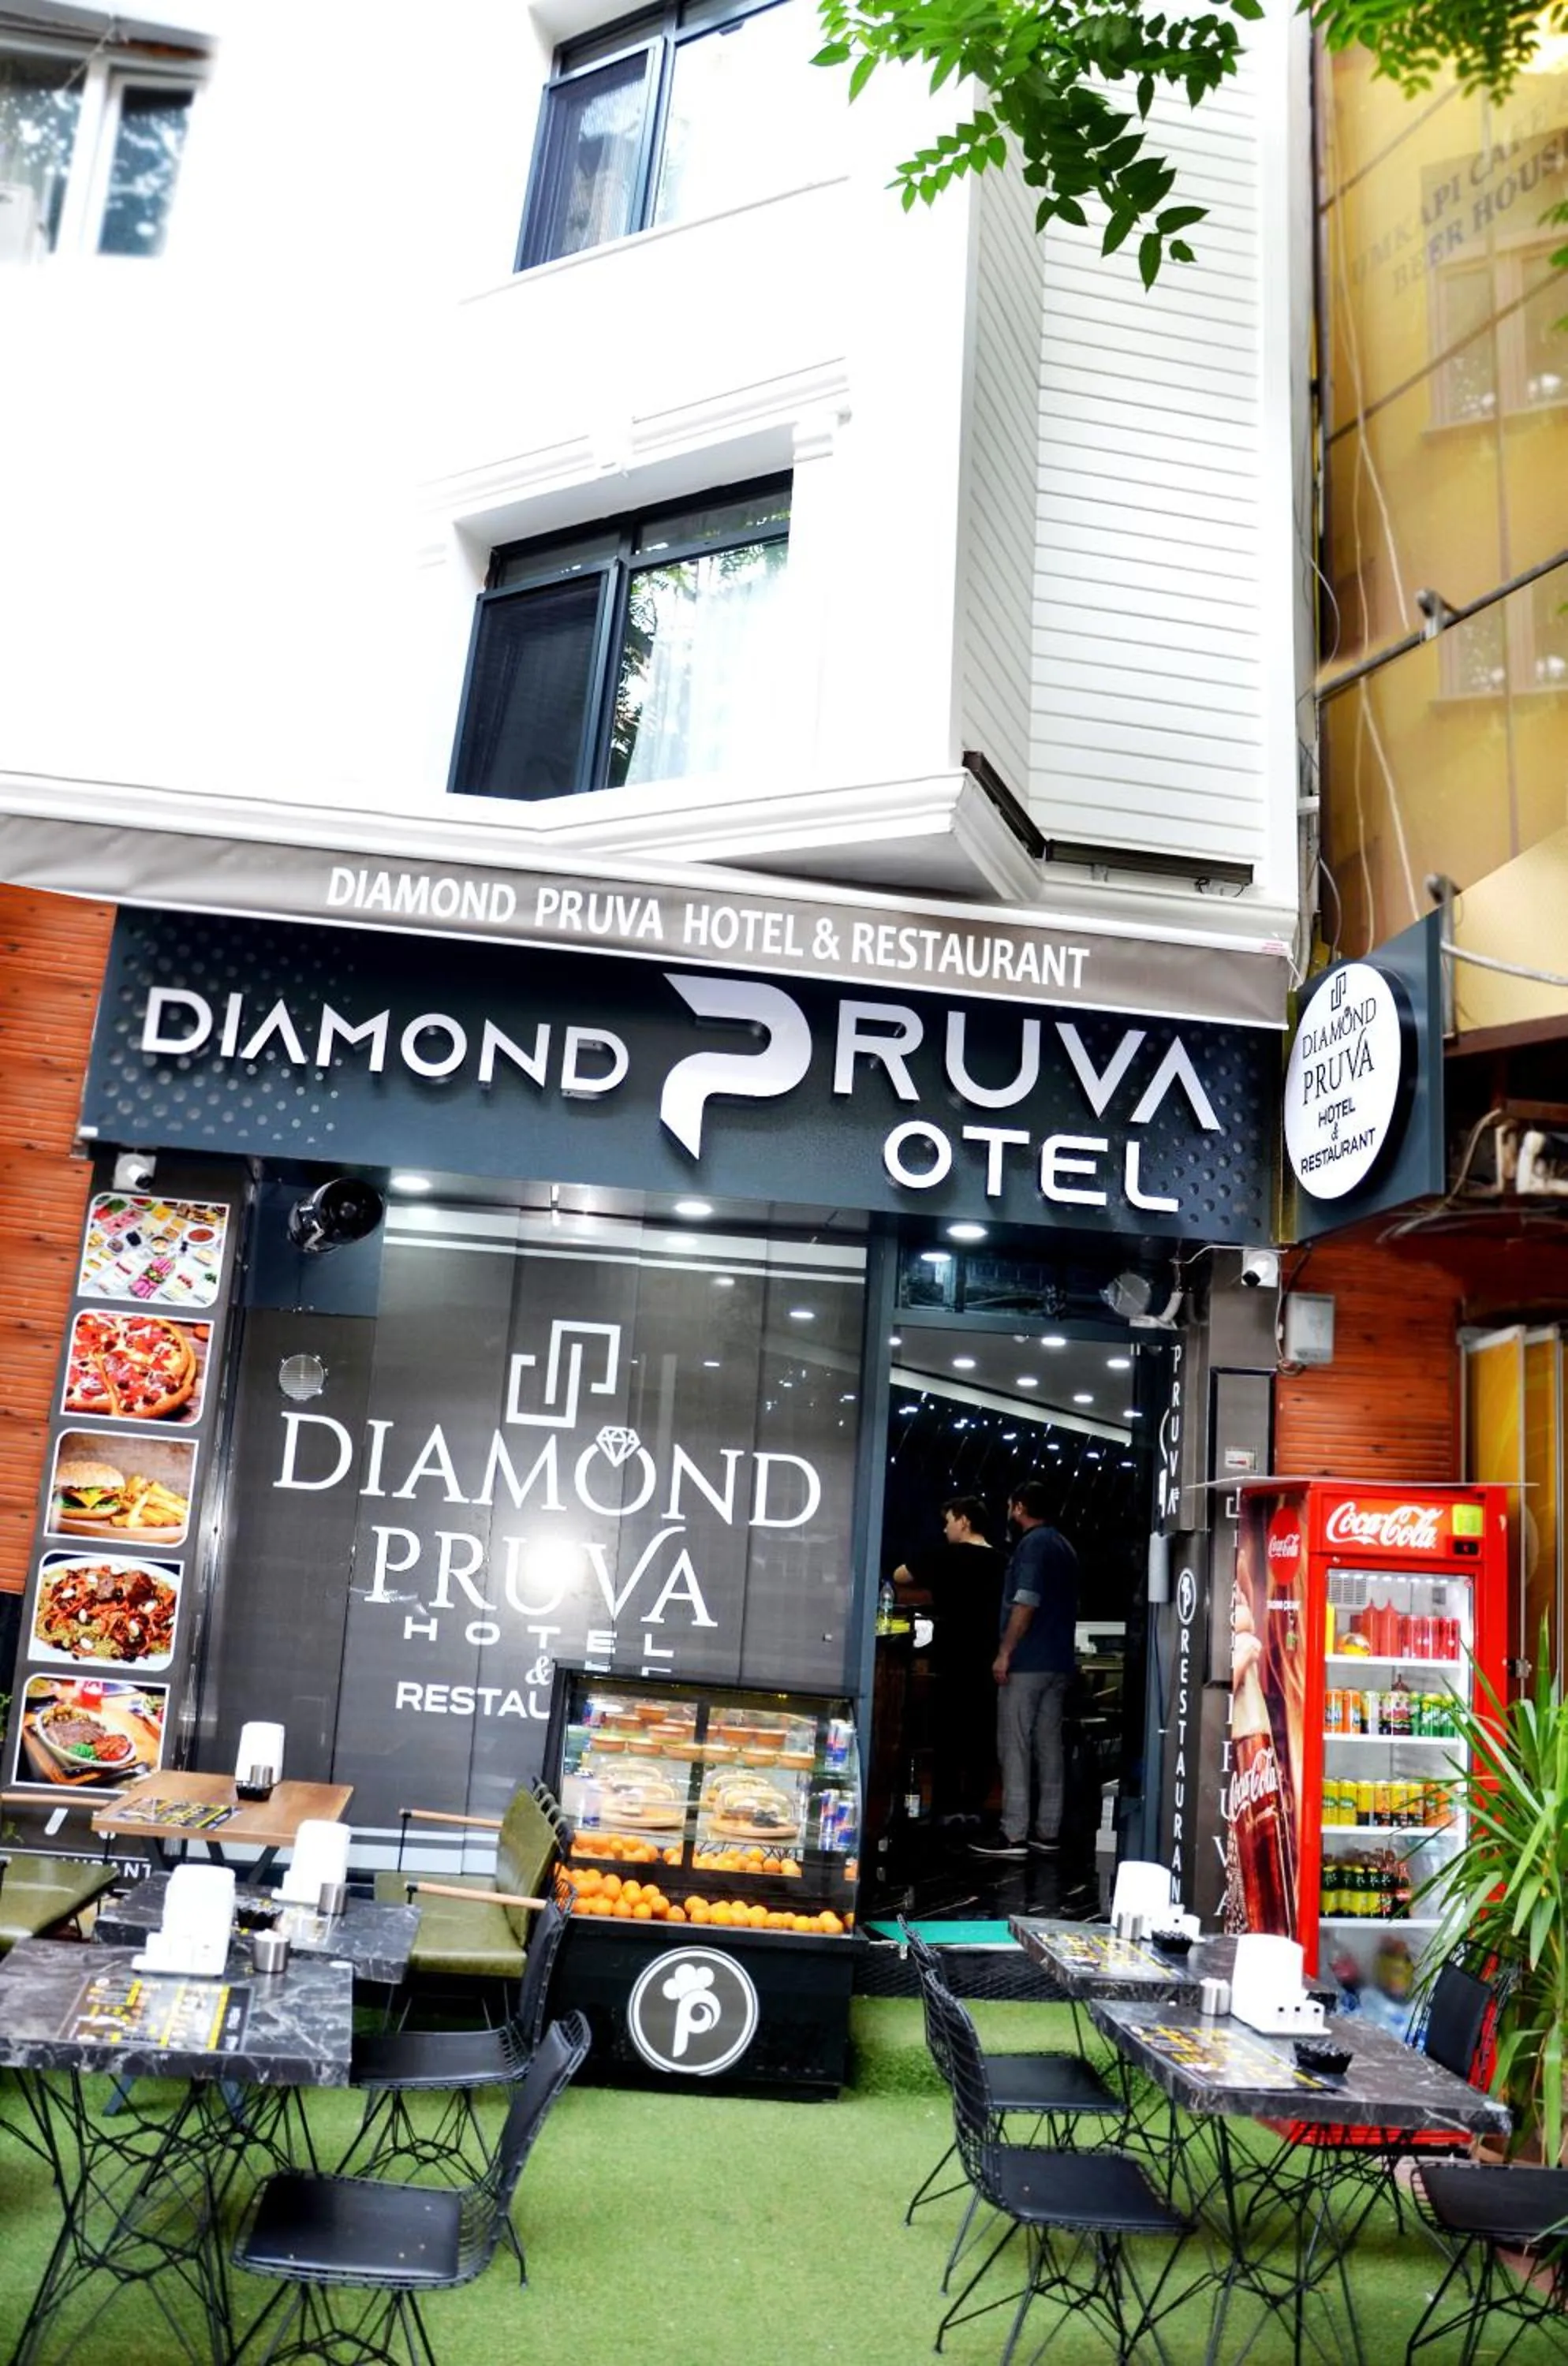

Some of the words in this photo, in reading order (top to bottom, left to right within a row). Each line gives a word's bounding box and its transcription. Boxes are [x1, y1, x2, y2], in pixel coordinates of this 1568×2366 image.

[1393, 218, 1464, 296] BEER
[326, 867, 517, 924] DIAMOND
[535, 888, 664, 940] PRUVA
[683, 904, 804, 957] HOTEL
[815, 917, 842, 961] &
[851, 923, 1090, 989] RESTAURANT
[140, 987, 630, 1096] DIAMOND
[660, 972, 1221, 1160] PRUVA
[1302, 997, 1376, 1059] DIAMOND
[1303, 1027, 1375, 1106] PRUVA
[1301, 1127, 1376, 1175] RESTAURANT
[1318, 1097, 1356, 1128] HOTEL
[1331, 1121, 1338, 1141] &
[883, 1121, 1179, 1212] OTEL
[1167, 1345, 1182, 1514] PRUVA
[273, 1411, 822, 1528] DIAMOND
[364, 1526, 718, 1628] PRUVA
[403, 1616, 674, 1658] HOTEL
[525, 1655, 552, 1686] &
[395, 1681, 551, 1719] RESTAU
[1171, 1629, 1189, 1904] RESTAURAN
